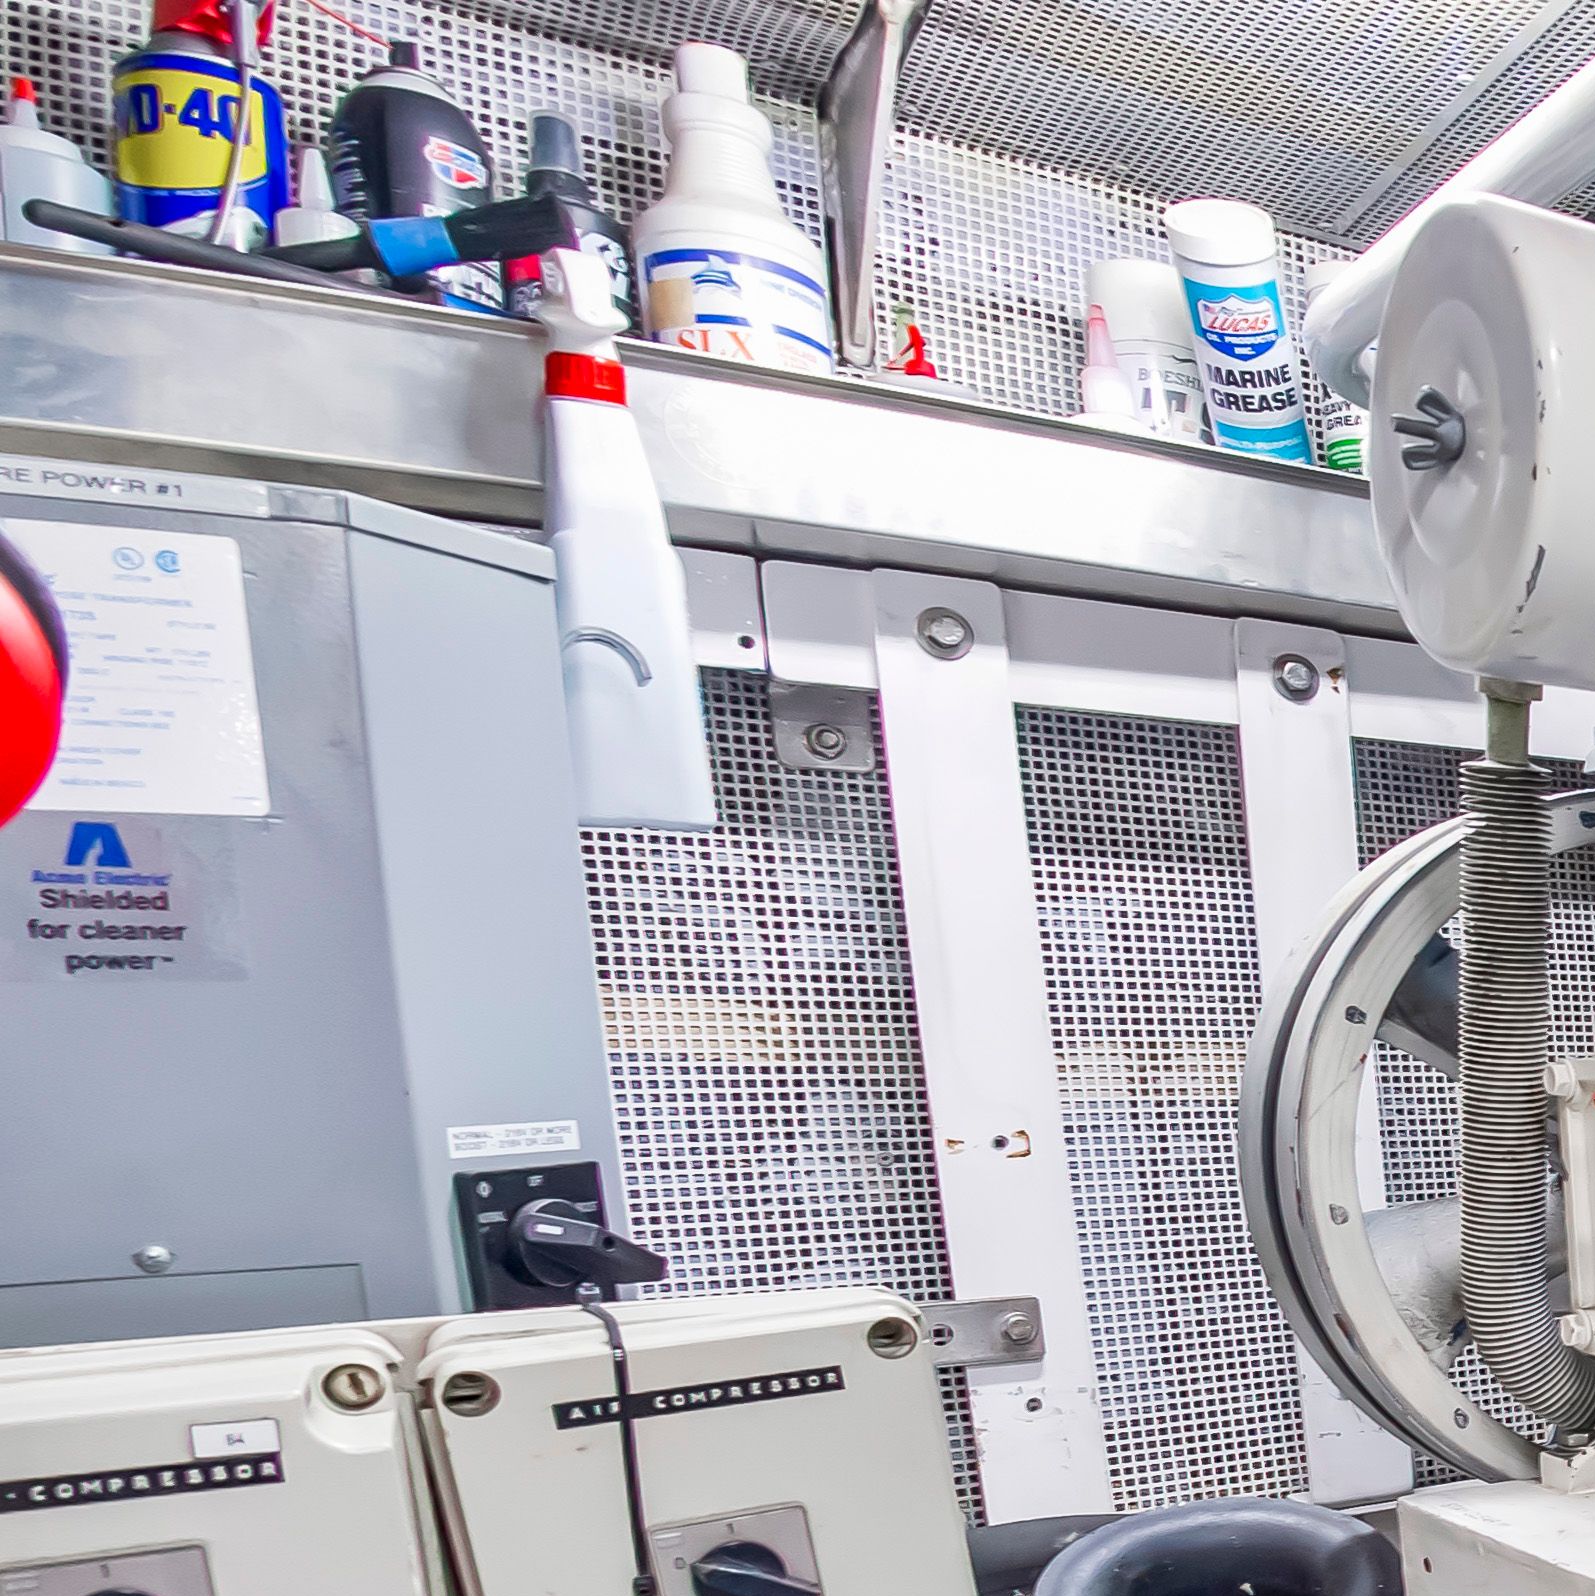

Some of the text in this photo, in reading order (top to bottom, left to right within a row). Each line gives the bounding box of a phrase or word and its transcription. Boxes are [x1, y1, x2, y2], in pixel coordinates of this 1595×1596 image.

[115, 84, 253, 145] D-40
[1206, 362, 1293, 389] MARINE
[1211, 386, 1299, 413] GREASE
[42, 470, 148, 496] POWER
[155, 482, 184, 498] #1
[39, 887, 171, 912] Shielded
[27, 917, 188, 942] for cleaner
[652, 1371, 840, 1411] COMPRESSOR
[28, 1460, 279, 1502] COMPRESSOR
